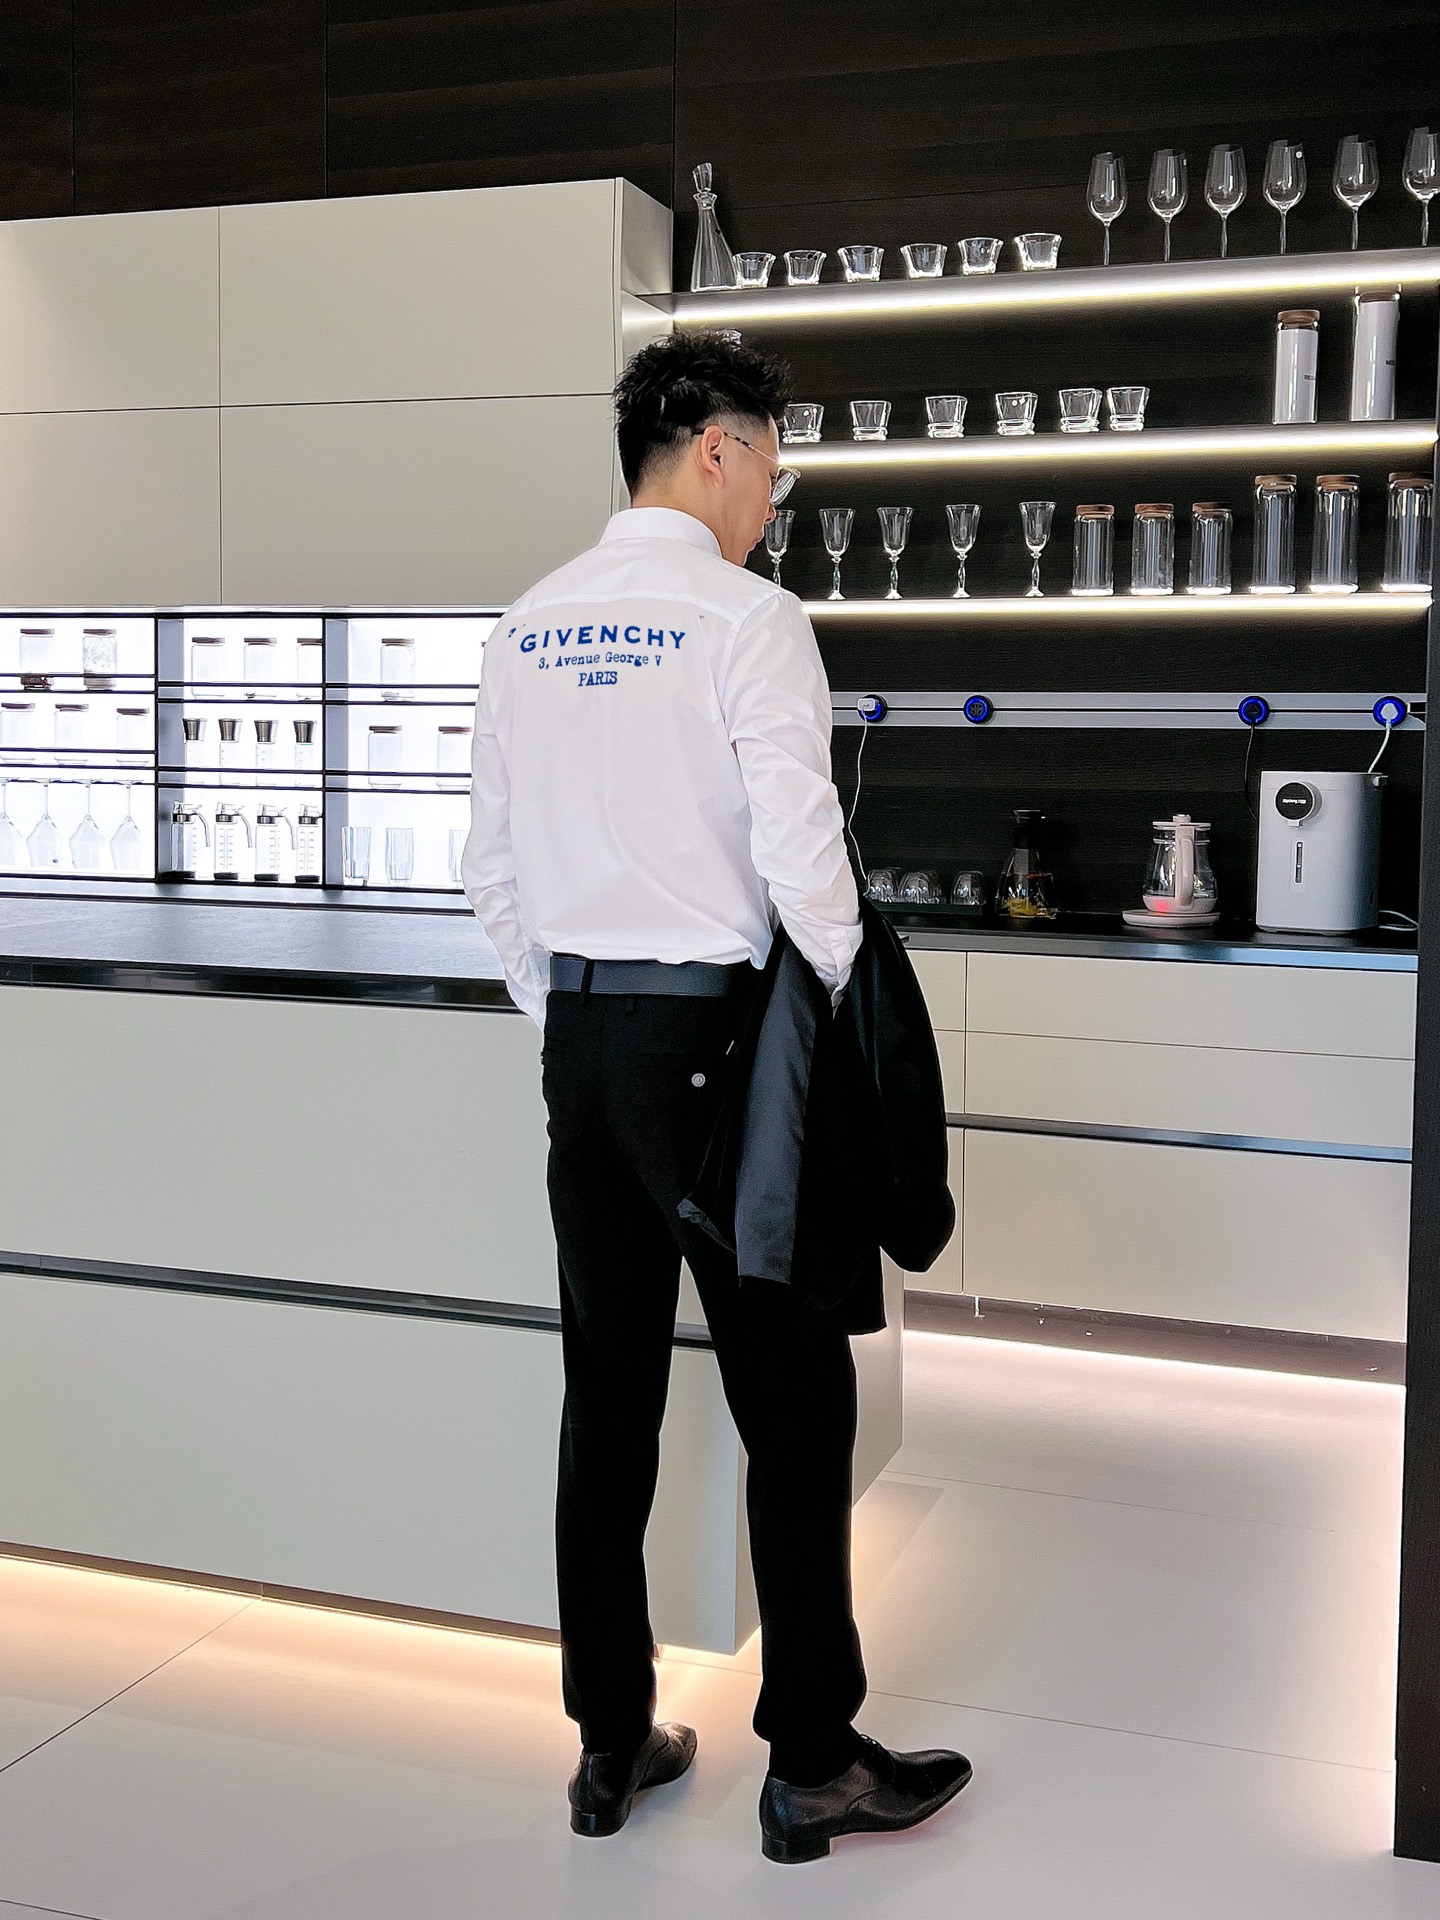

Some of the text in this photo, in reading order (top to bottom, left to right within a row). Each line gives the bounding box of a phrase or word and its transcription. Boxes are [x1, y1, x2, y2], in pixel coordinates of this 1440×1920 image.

[520, 625, 686, 653] GIVENCHY
[538, 651, 662, 670] 3, Avenue George V
[578, 671, 618, 687] PARIS
